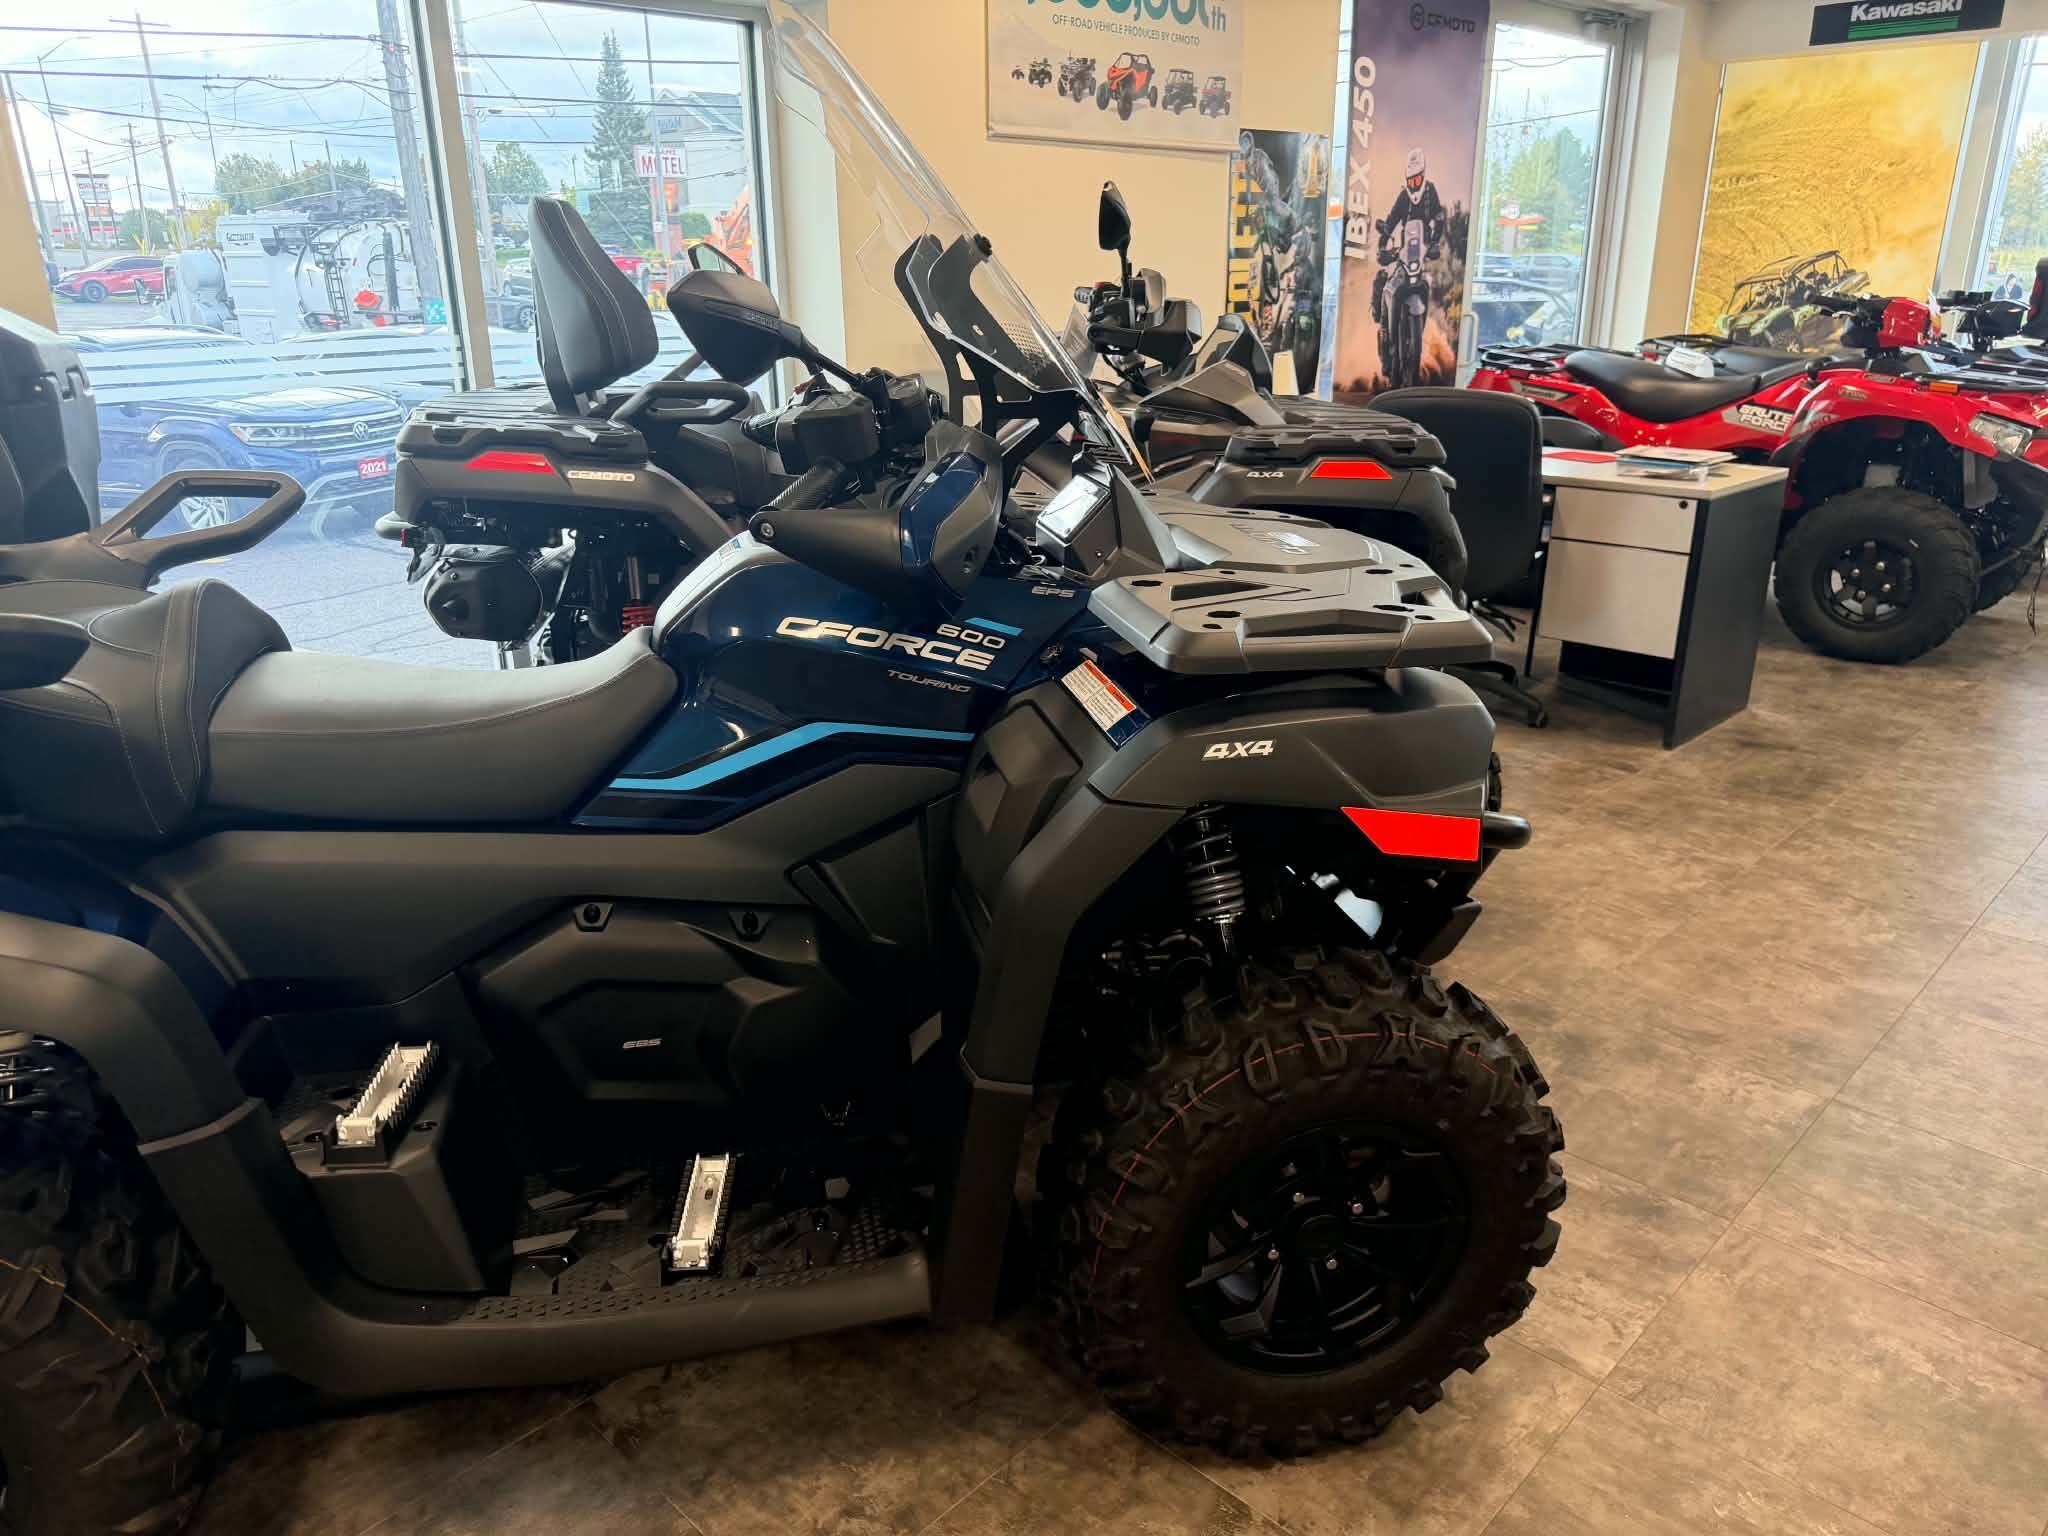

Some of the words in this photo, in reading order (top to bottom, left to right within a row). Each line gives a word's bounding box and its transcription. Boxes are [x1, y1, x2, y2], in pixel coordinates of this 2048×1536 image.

[1851, 0, 1963, 22] Kawasaki
[1093, 19, 1123, 36] VEHICLE
[1352, 56, 1377, 148] 450
[640, 155, 685, 175] MTEL
[1344, 157, 1371, 259] IBEX
[1739, 404, 1794, 422] BRUTE
[360, 460, 388, 475] 2021
[1031, 585, 1076, 598] EPS
[775, 616, 996, 671] CFORCE
[936, 623, 1008, 650] 600
[887, 669, 972, 694] TOURING
